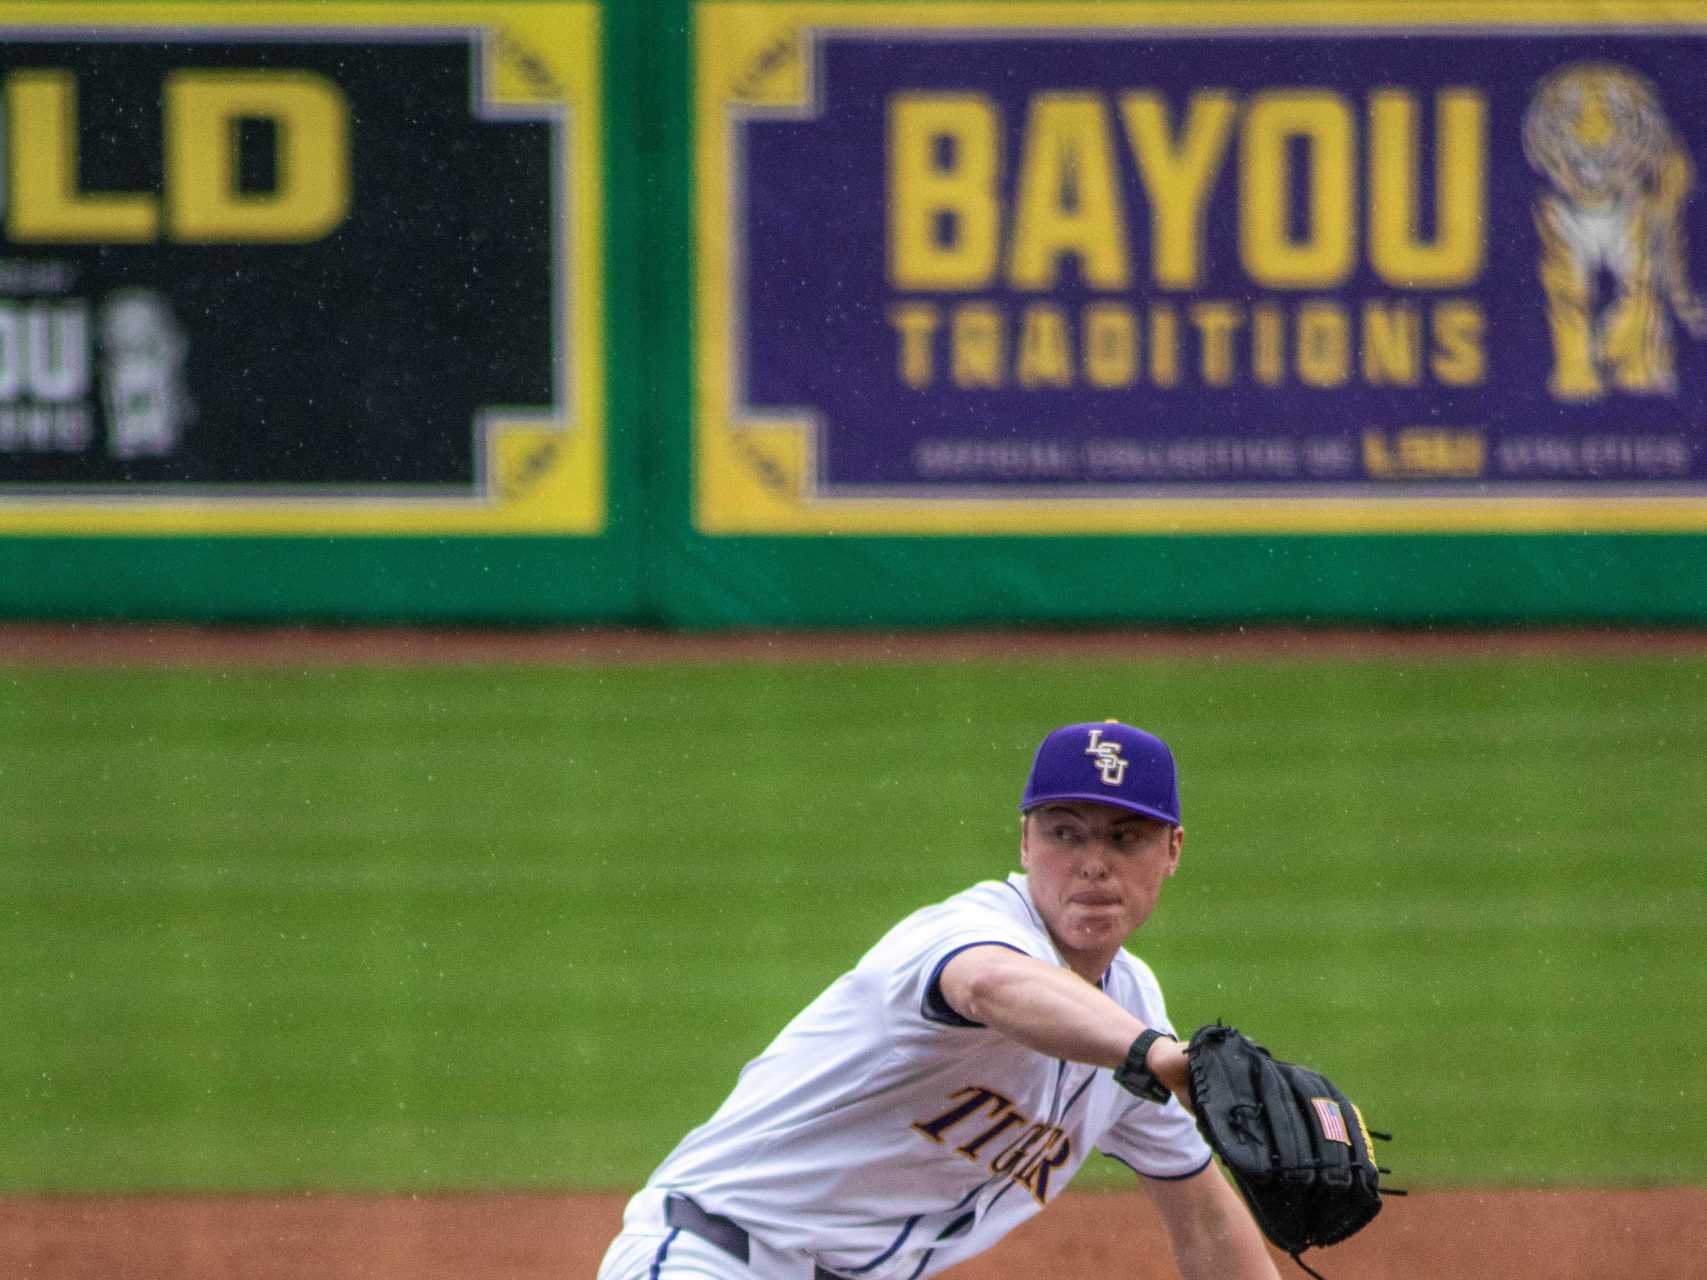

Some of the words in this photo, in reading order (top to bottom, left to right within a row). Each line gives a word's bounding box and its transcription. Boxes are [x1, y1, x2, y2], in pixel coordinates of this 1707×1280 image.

[888, 90, 1487, 289] BAYOU
[890, 302, 1487, 388] TRADITIONS
[1085, 729, 1128, 786] LSU
